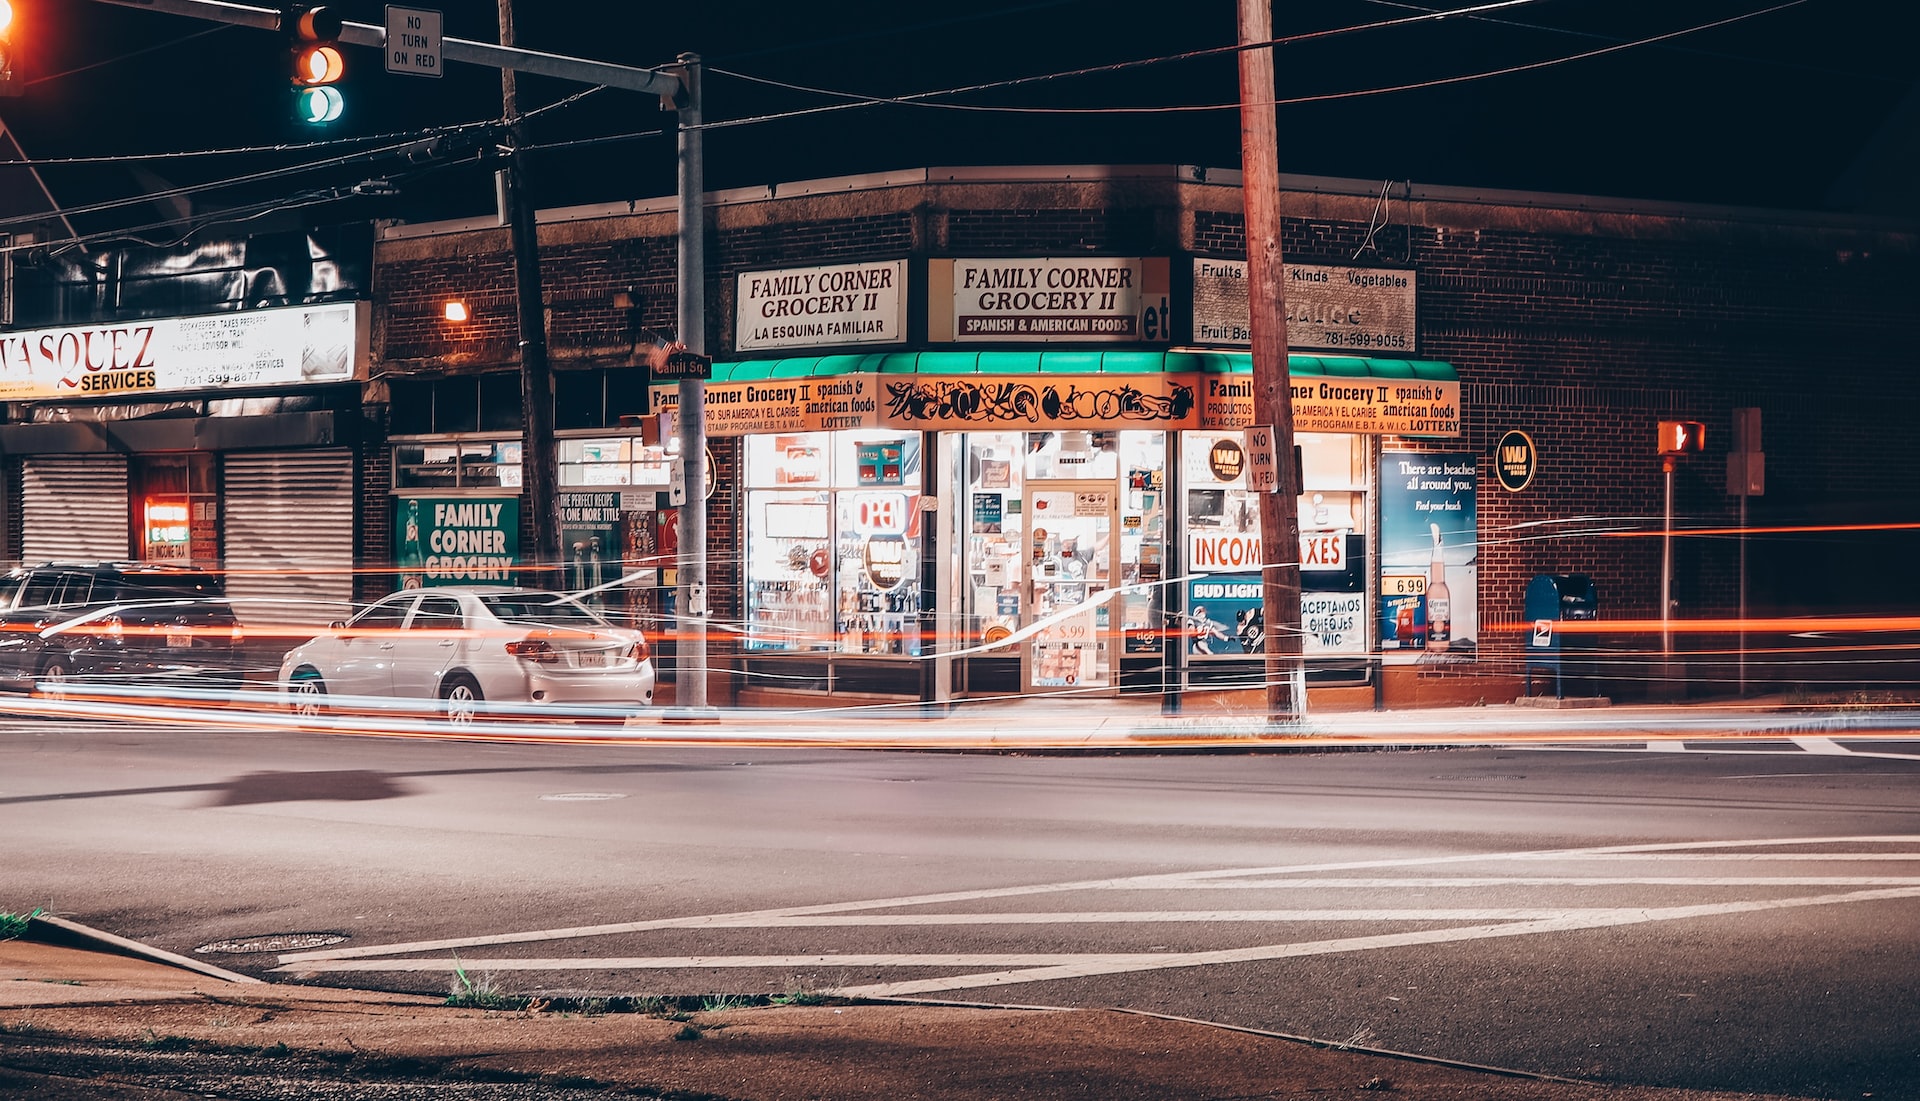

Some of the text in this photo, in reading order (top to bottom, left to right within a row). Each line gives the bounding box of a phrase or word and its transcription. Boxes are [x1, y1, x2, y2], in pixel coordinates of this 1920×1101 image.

[407, 15, 421, 30] NO
[401, 33, 428, 49] TURN
[393, 51, 435, 68] ON RED
[750, 268, 892, 299] FAMILY CORNER
[963, 268, 1133, 289] FAMILY CORNER
[1201, 263, 1408, 288] Fruits Kinds Vegetables
[761, 292, 879, 318] GROCERY II
[978, 291, 1117, 311] GROCERY II
[220, 318, 239, 329] TAXES
[754, 319, 884, 340] LA ESQUINA FAMILIAR
[966, 318, 1129, 333] SPANISH & AMERICAN FOODS
[1201, 324, 1228, 339] Fruit
[202, 340, 229, 351] ADVISOR
[0, 326, 156, 390] VASQUEZ
[255, 358, 285, 370] SERVICES
[689, 361, 707, 375] Sq.
[81, 371, 156, 392] SERVICES
[183, 371, 261, 385] 781-599-8877
[653, 390, 679, 407] Fam
[746, 385, 797, 405] Grocery
[799, 384, 811, 401] II
[817, 379, 863, 400] spanish &
[1209, 379, 1252, 398] Famil
[1319, 382, 1374, 406] Grocery
[1376, 386, 1389, 403] II
[1395, 384, 1443, 403] spanish &
[717, 409, 731, 420] SUR
[731, 407, 760, 420] AMERICA
[761, 407, 766, 419] Y
[766, 407, 775, 419] EL
[776, 406, 800, 418] CARIBE
[805, 396, 876, 414] american foods
[1207, 403, 1253, 415] PRODUCTOS
[1302, 405, 1334, 417] AMERICA
[1335, 406, 1340, 417] Y
[1341, 406, 1350, 418] EL
[1352, 407, 1377, 419] CARIBE
[1383, 402, 1455, 419] american foods
[707, 422, 729, 432] STAMP
[730, 420, 763, 431] PROGRAM
[782, 420, 787, 429] &
[821, 415, 863, 429] LOTTERY
[1203, 416, 1216, 427] WE
[1217, 417, 1253, 427] ACCEPT
[1311, 419, 1354, 430] PROGRAM
[1379, 421, 1385, 430] &
[1387, 421, 1409, 432] W.I.C.
[1409, 419, 1460, 432] LOTTERY
[1253, 433, 1267, 447] NO
[1212, 449, 1241, 466] WU
[1250, 452, 1271, 466] TURN
[1501, 445, 1528, 464] WU
[1398, 460, 1476, 475] There are beaches
[1260, 471, 1275, 484] RED
[1406, 476, 1473, 494] all around you.
[560, 493, 571, 508] THE
[571, 493, 594, 508] PERFECT
[594, 493, 614, 508] RECIPE
[1415, 500, 1462, 514] Find your beach
[434, 503, 503, 527] FAMILY
[566, 507, 581, 522] ONE
[581, 507, 602, 522] MORE
[602, 507, 620, 522] TITLE
[860, 500, 900, 530] OPEN
[429, 529, 506, 554] CORNER
[175, 544, 186, 558] TAX
[1195, 536, 1262, 567] INCOM
[425, 555, 513, 580] GROCERY
[1193, 583, 1263, 599] BUD LIGHT
[1397, 579, 1423, 593] 6.99
[1302, 599, 1360, 615] ACEPTAMOS
[1321, 633, 1342, 647] WIC
